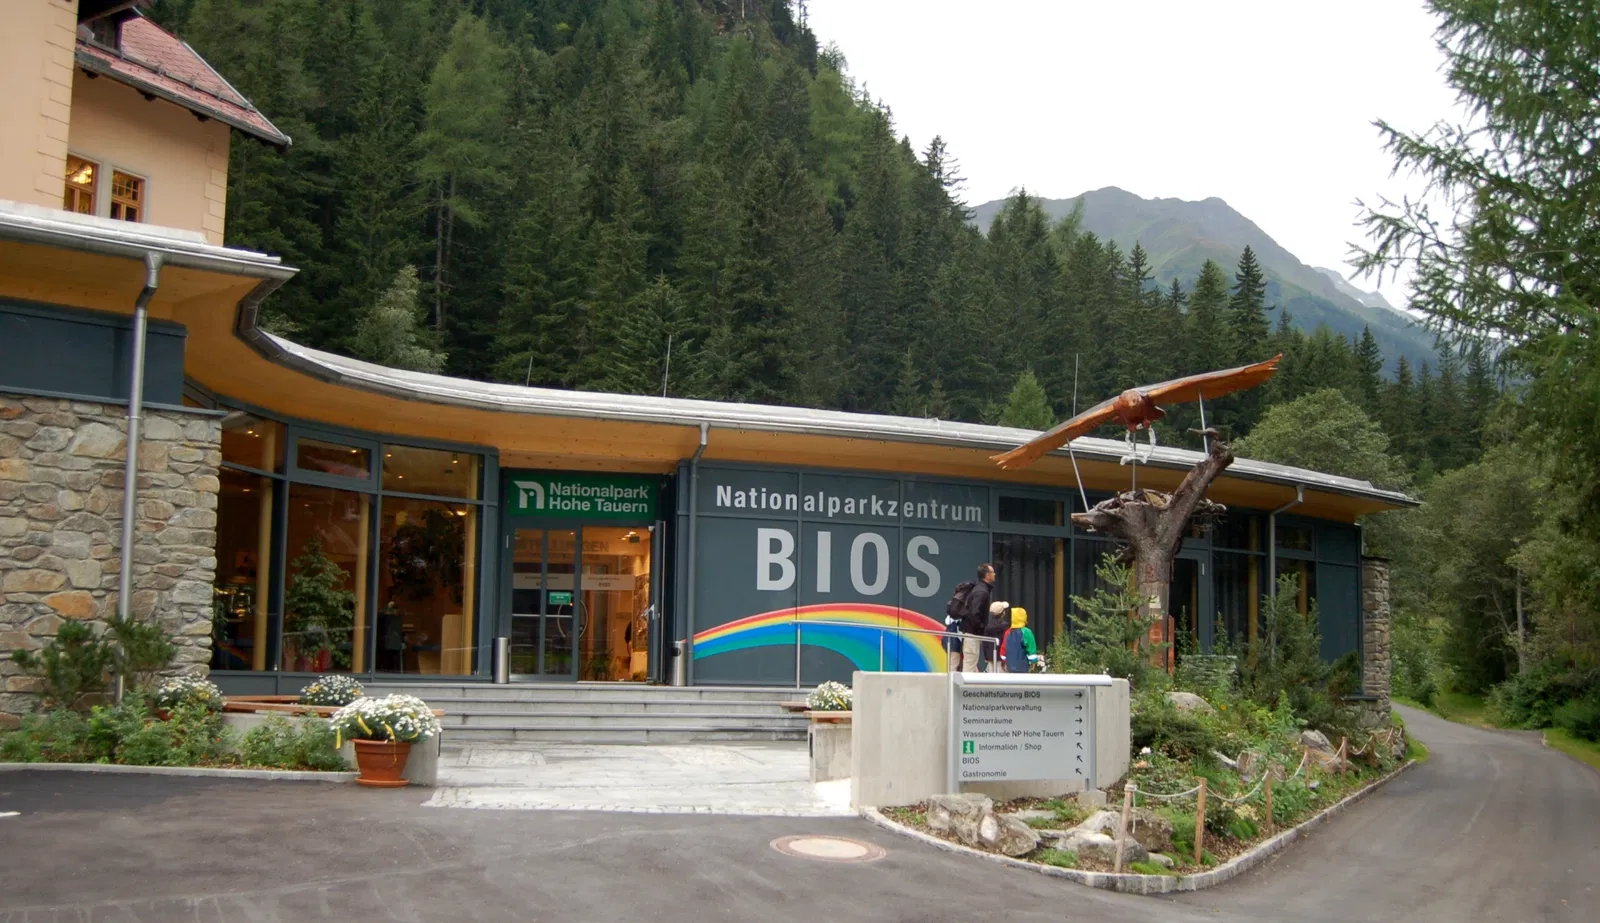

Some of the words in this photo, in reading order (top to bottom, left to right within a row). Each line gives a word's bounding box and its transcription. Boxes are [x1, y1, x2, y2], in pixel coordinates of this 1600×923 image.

[549, 482, 648, 499] Nationalpark
[549, 497, 590, 511] Hohe
[595, 498, 648, 512] Tauern
[716, 485, 982, 522] Nationalparkzentrum
[756, 527, 941, 598] BIOS
[962, 690, 1023, 699] Geschäftsführung
[962, 704, 1042, 713] Nationalparkverwaltung
[962, 717, 1013, 725] Seminarräume
[962, 730, 1011, 738] Wasserschule
[1012, 730, 1022, 738] NP
[1023, 730, 1041, 738] Hohe
[1042, 730, 1065, 738] Tauern
[978, 743, 1018, 751] Information
[1024, 743, 1042, 752] Shop
[962, 757, 980, 765] BIOS
[962, 770, 1007, 778] Gastronomie
